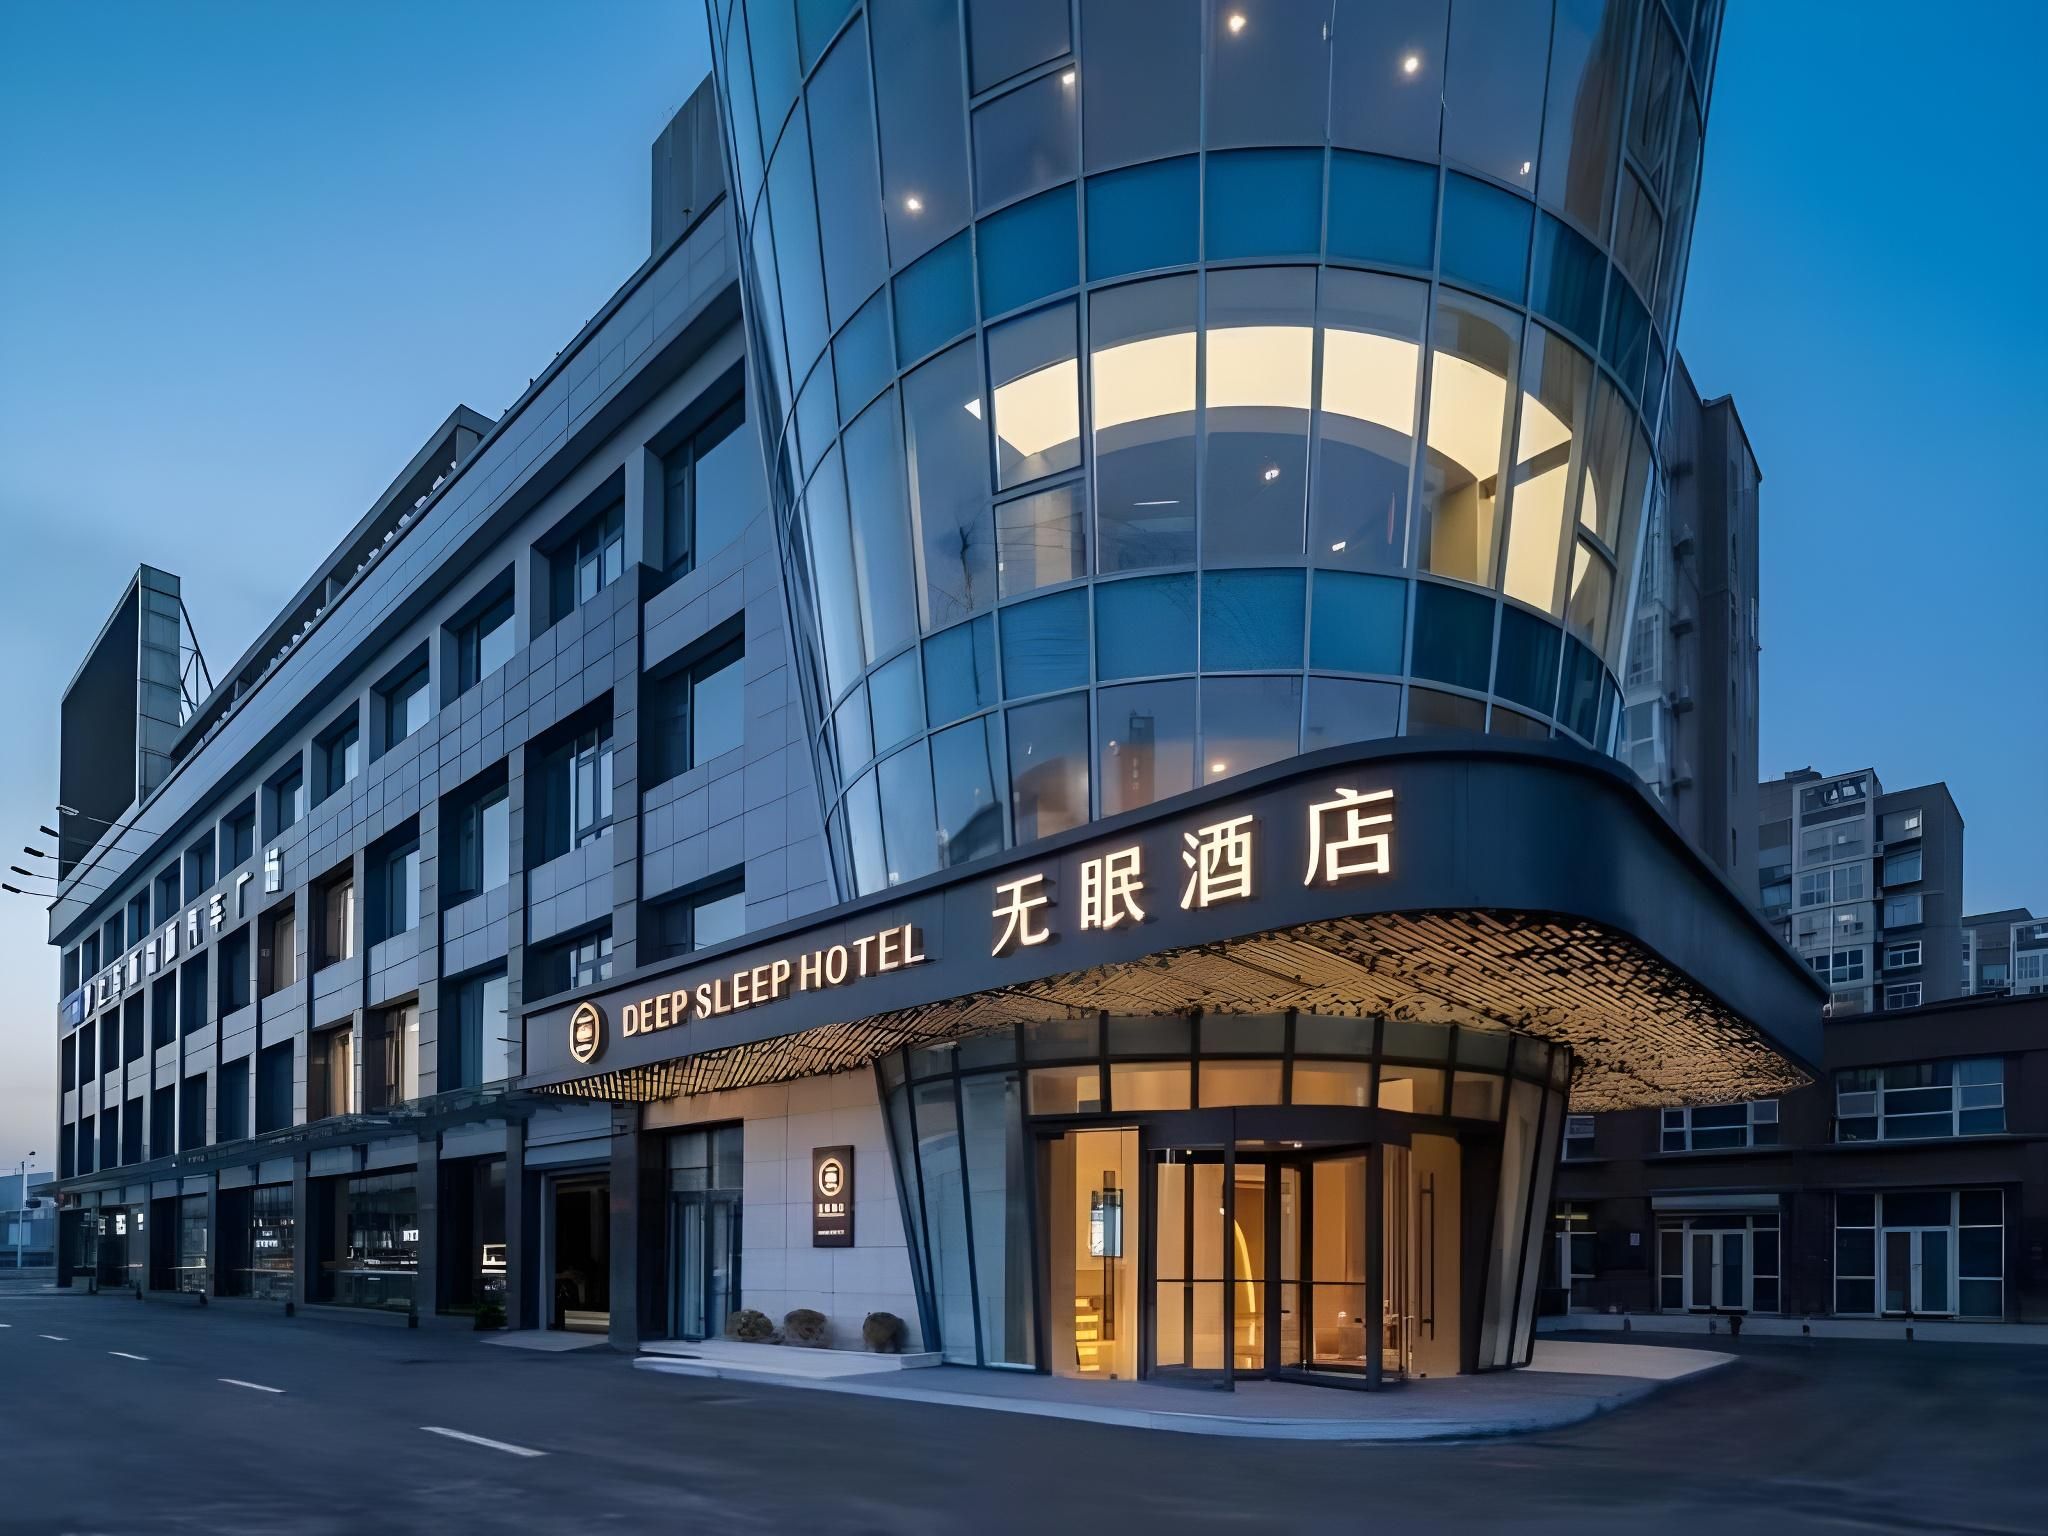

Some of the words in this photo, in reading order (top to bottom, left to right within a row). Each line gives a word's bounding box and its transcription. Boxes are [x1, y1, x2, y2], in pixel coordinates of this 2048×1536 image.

[991, 787, 1395, 957] 无眠酒店
[623, 989, 688, 1038] DEEP
[696, 958, 790, 1020] SLEEP
[800, 923, 925, 991] HOTEL
